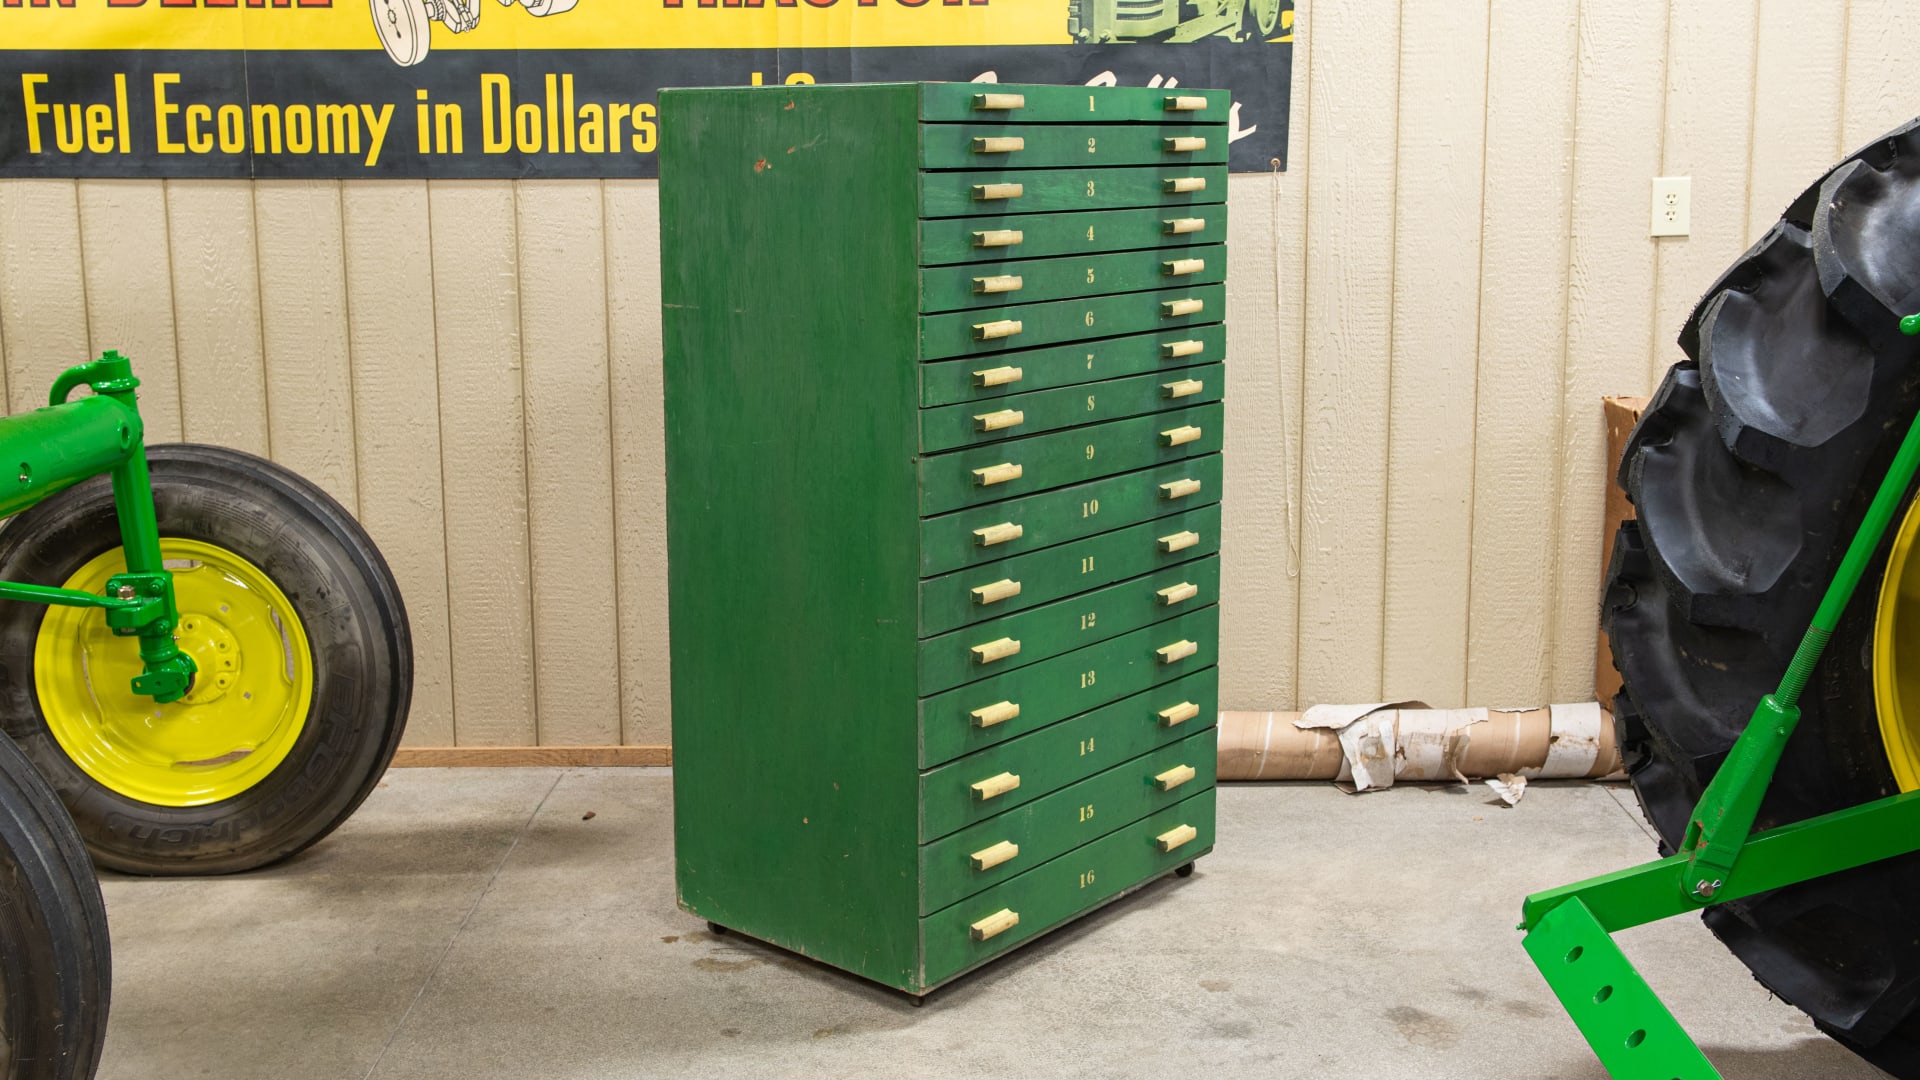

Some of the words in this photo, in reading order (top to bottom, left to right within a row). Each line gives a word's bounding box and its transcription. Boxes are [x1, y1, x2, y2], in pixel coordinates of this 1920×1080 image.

[1089, 95, 1095, 111] 1
[21, 72, 131, 154] Fuel
[152, 72, 396, 167] Economy
[415, 88, 464, 154] in
[480, 72, 657, 154] Dollars
[1087, 138, 1096, 153] 2
[1087, 181, 1095, 196] 3
[1087, 226, 1095, 241] 4
[1087, 268, 1095, 283] 5
[1084, 311, 1095, 326] 6
[1086, 353, 1095, 369] 7
[1085, 445, 1095, 458] 9
[1083, 499, 1099, 518] 10
[1082, 556, 1094, 574] 11
[1081, 613, 1096, 630] 12
[1081, 671, 1096, 689] 13
[1080, 738, 1095, 756] 14
[1079, 805, 1094, 822] 15
[1080, 872, 1095, 889] 16
